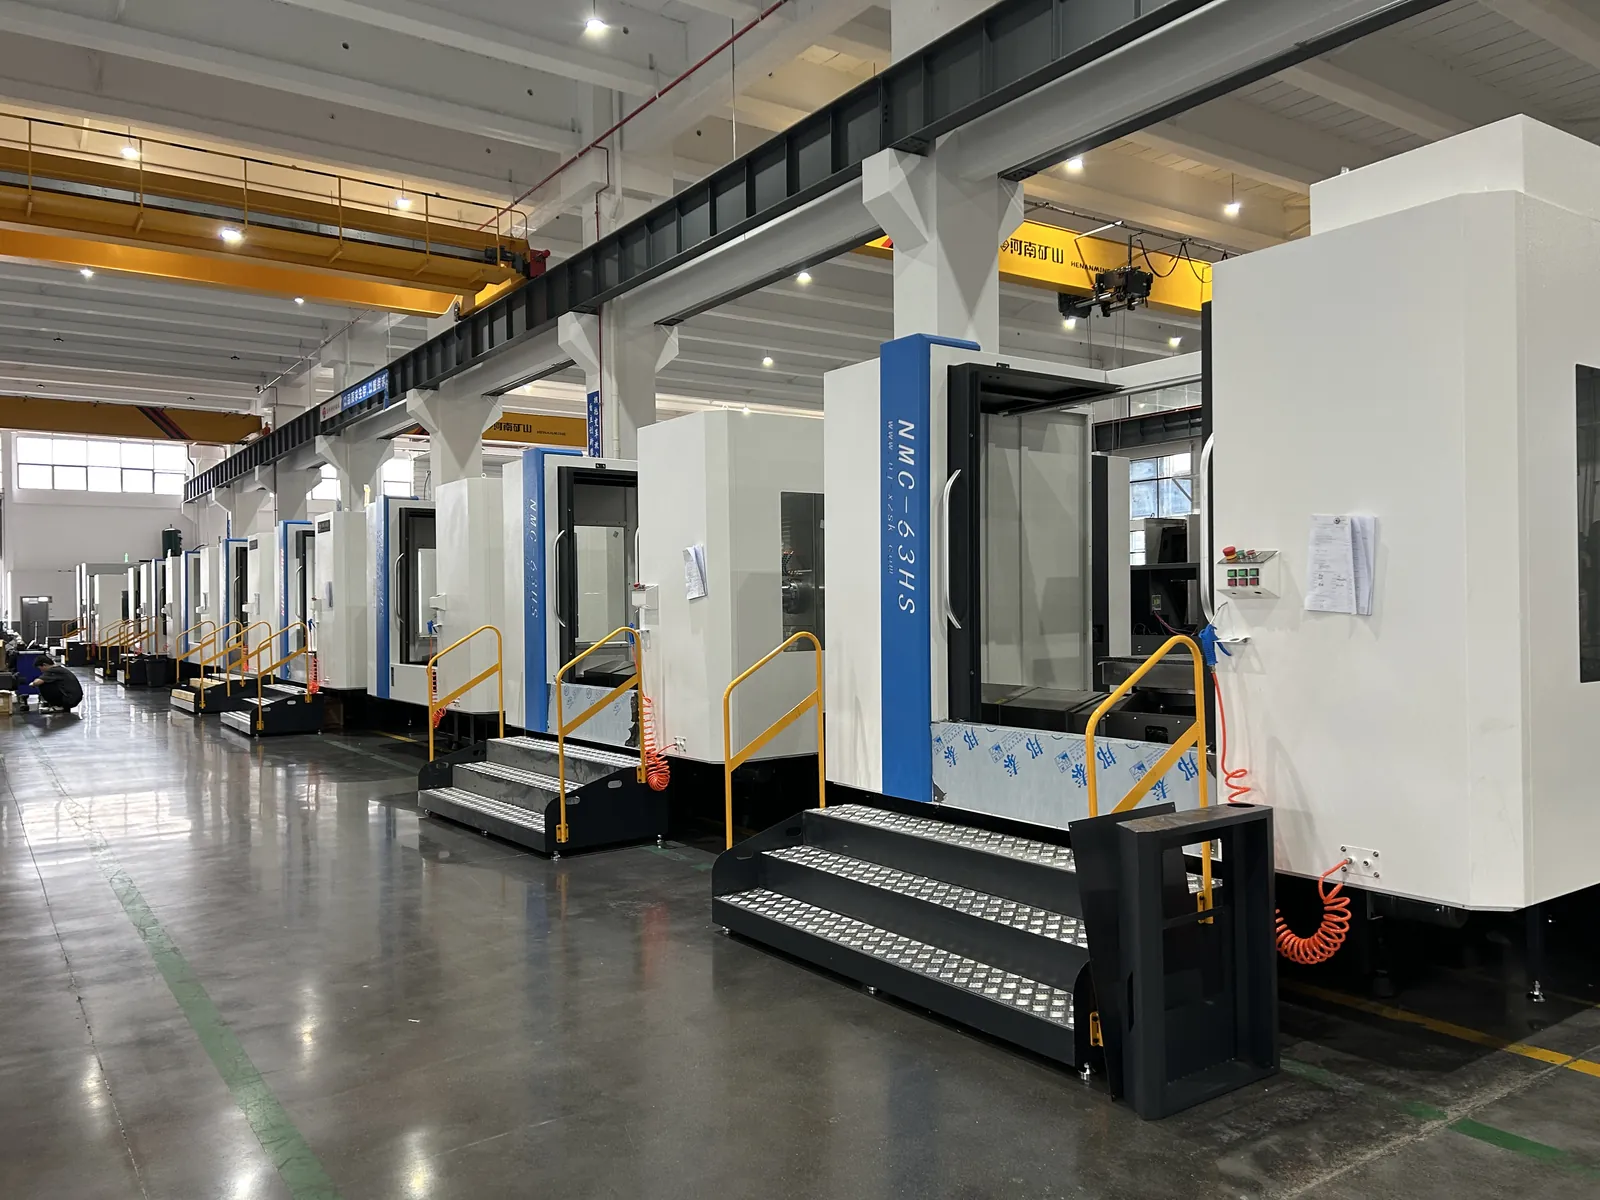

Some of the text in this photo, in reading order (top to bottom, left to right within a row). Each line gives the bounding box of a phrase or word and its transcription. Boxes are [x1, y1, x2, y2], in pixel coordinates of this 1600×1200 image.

[1010, 238, 1064, 264] 河南矿山
[494, 422, 532, 433] 河南矿山
[898, 419, 916, 614] NMC-63HS
